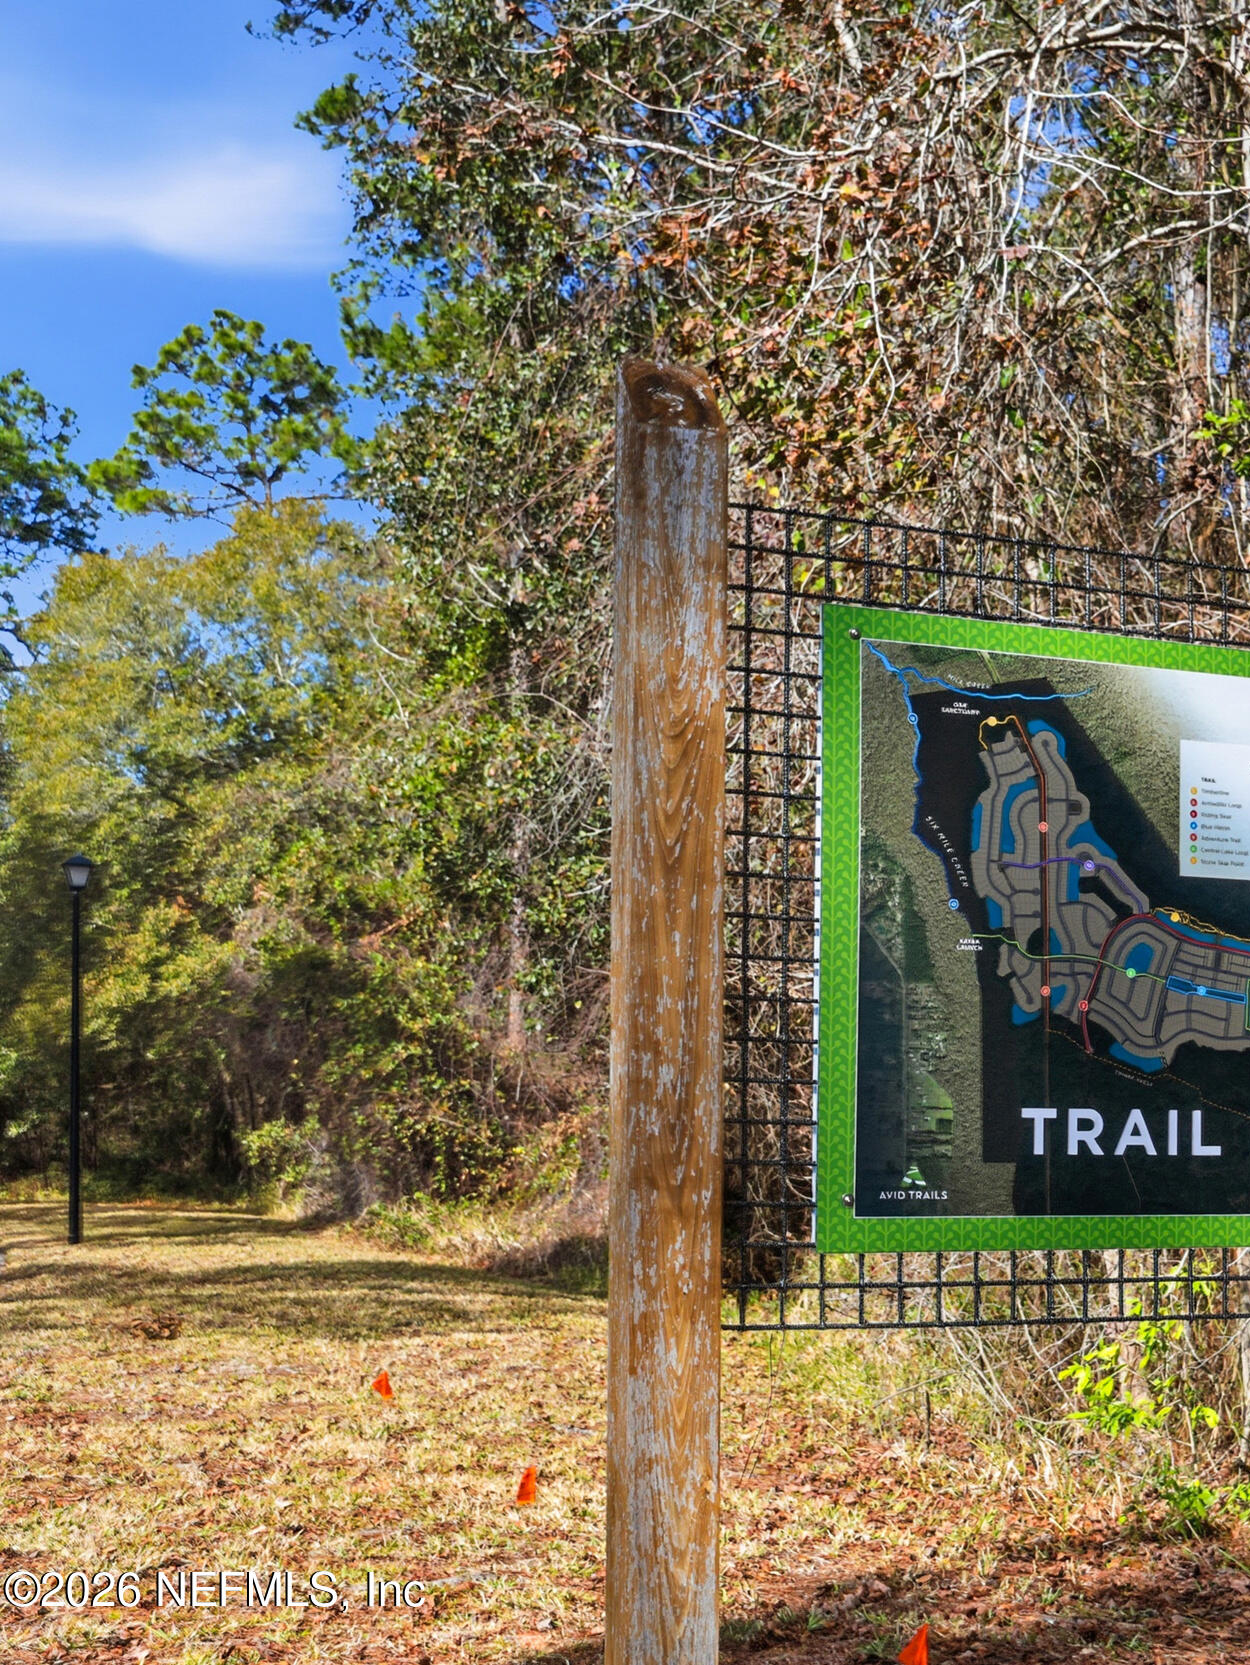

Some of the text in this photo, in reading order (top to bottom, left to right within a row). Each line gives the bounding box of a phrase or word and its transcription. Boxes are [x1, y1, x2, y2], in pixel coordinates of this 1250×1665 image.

[925, 816, 939, 830] SIX
[938, 832, 954, 853] MILE
[1021, 1108, 1221, 1156] TRAIL
[880, 1191, 948, 1200] AVID TRAILS
